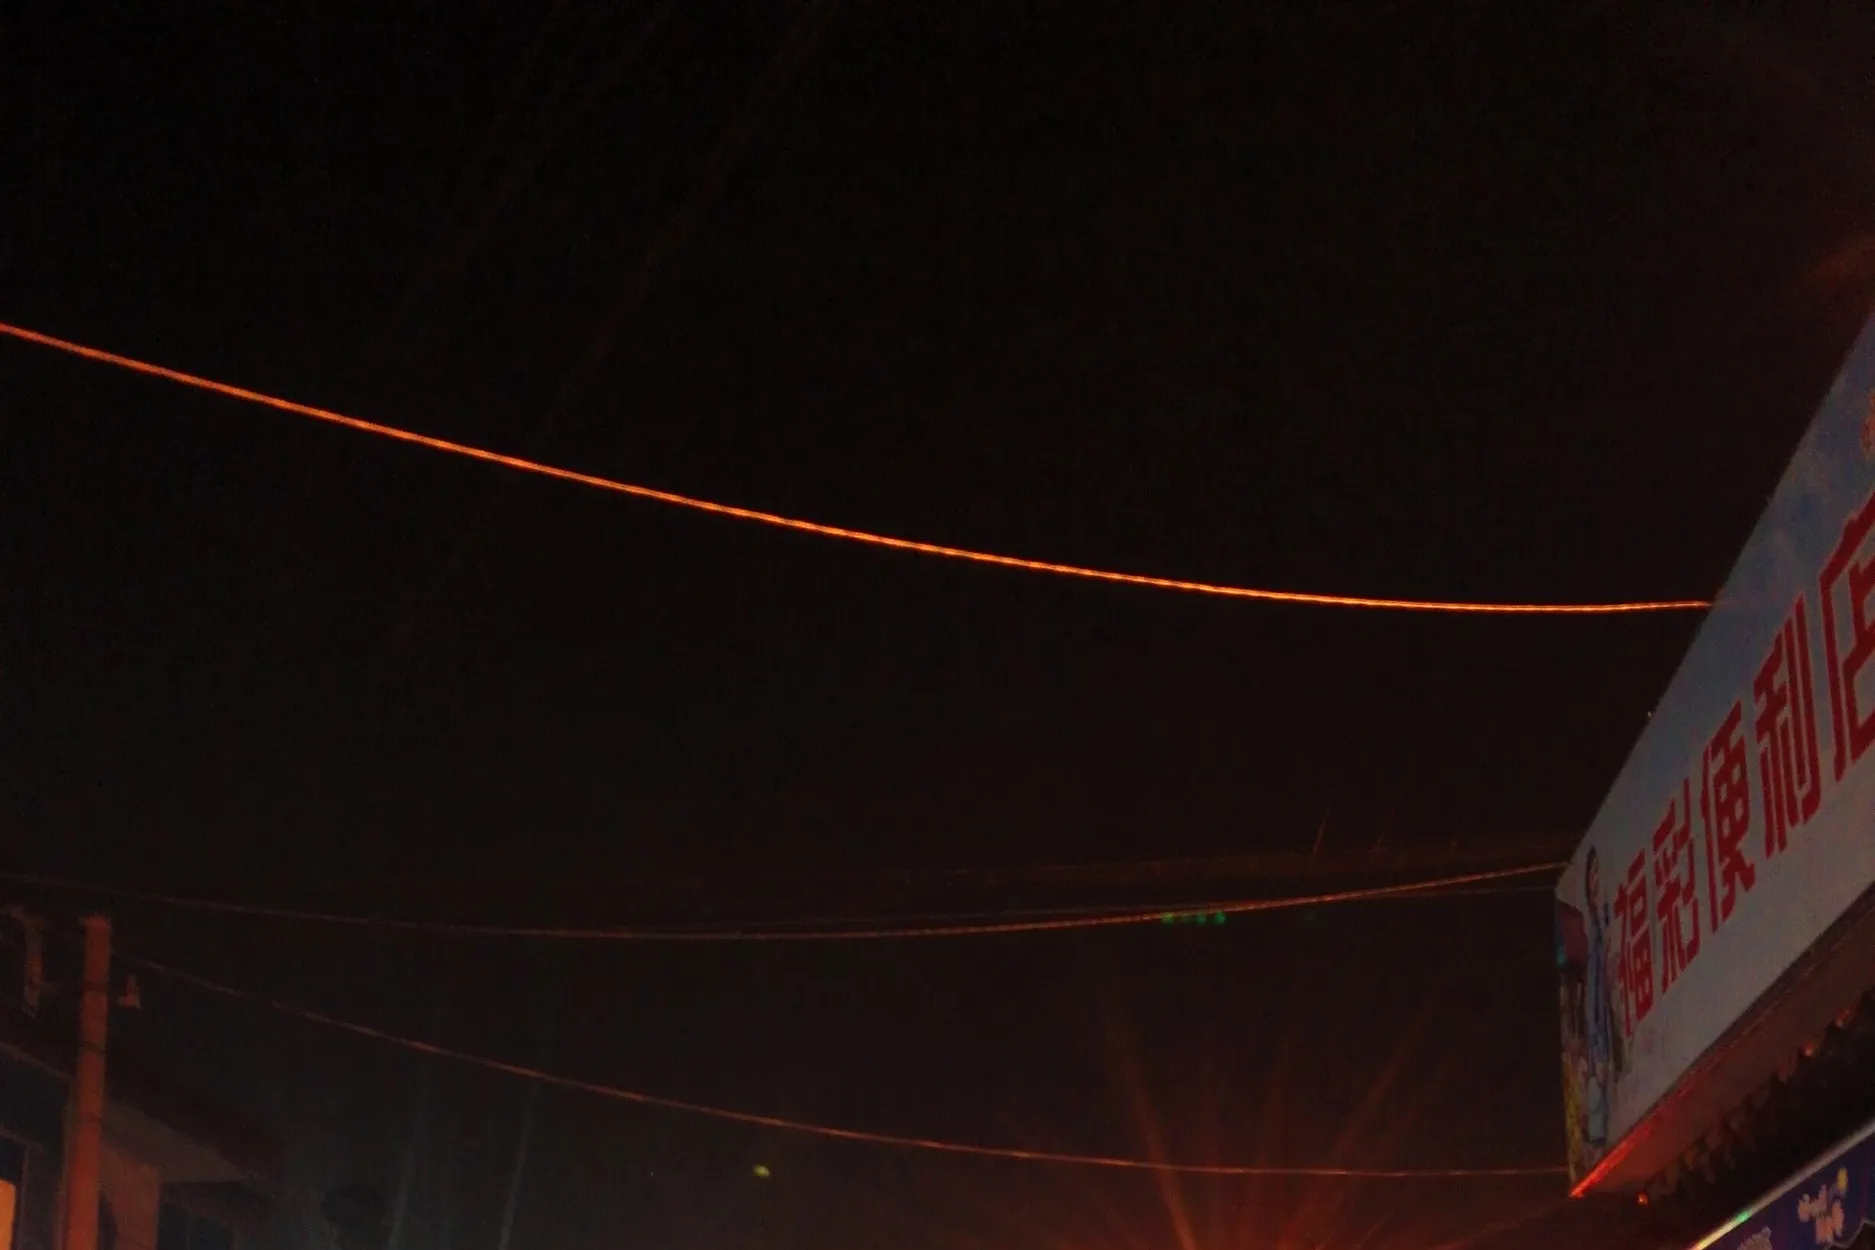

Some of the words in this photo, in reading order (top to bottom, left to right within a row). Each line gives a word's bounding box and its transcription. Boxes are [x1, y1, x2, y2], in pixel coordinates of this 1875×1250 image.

[1613, 491, 1875, 1037] 福彩便利店
